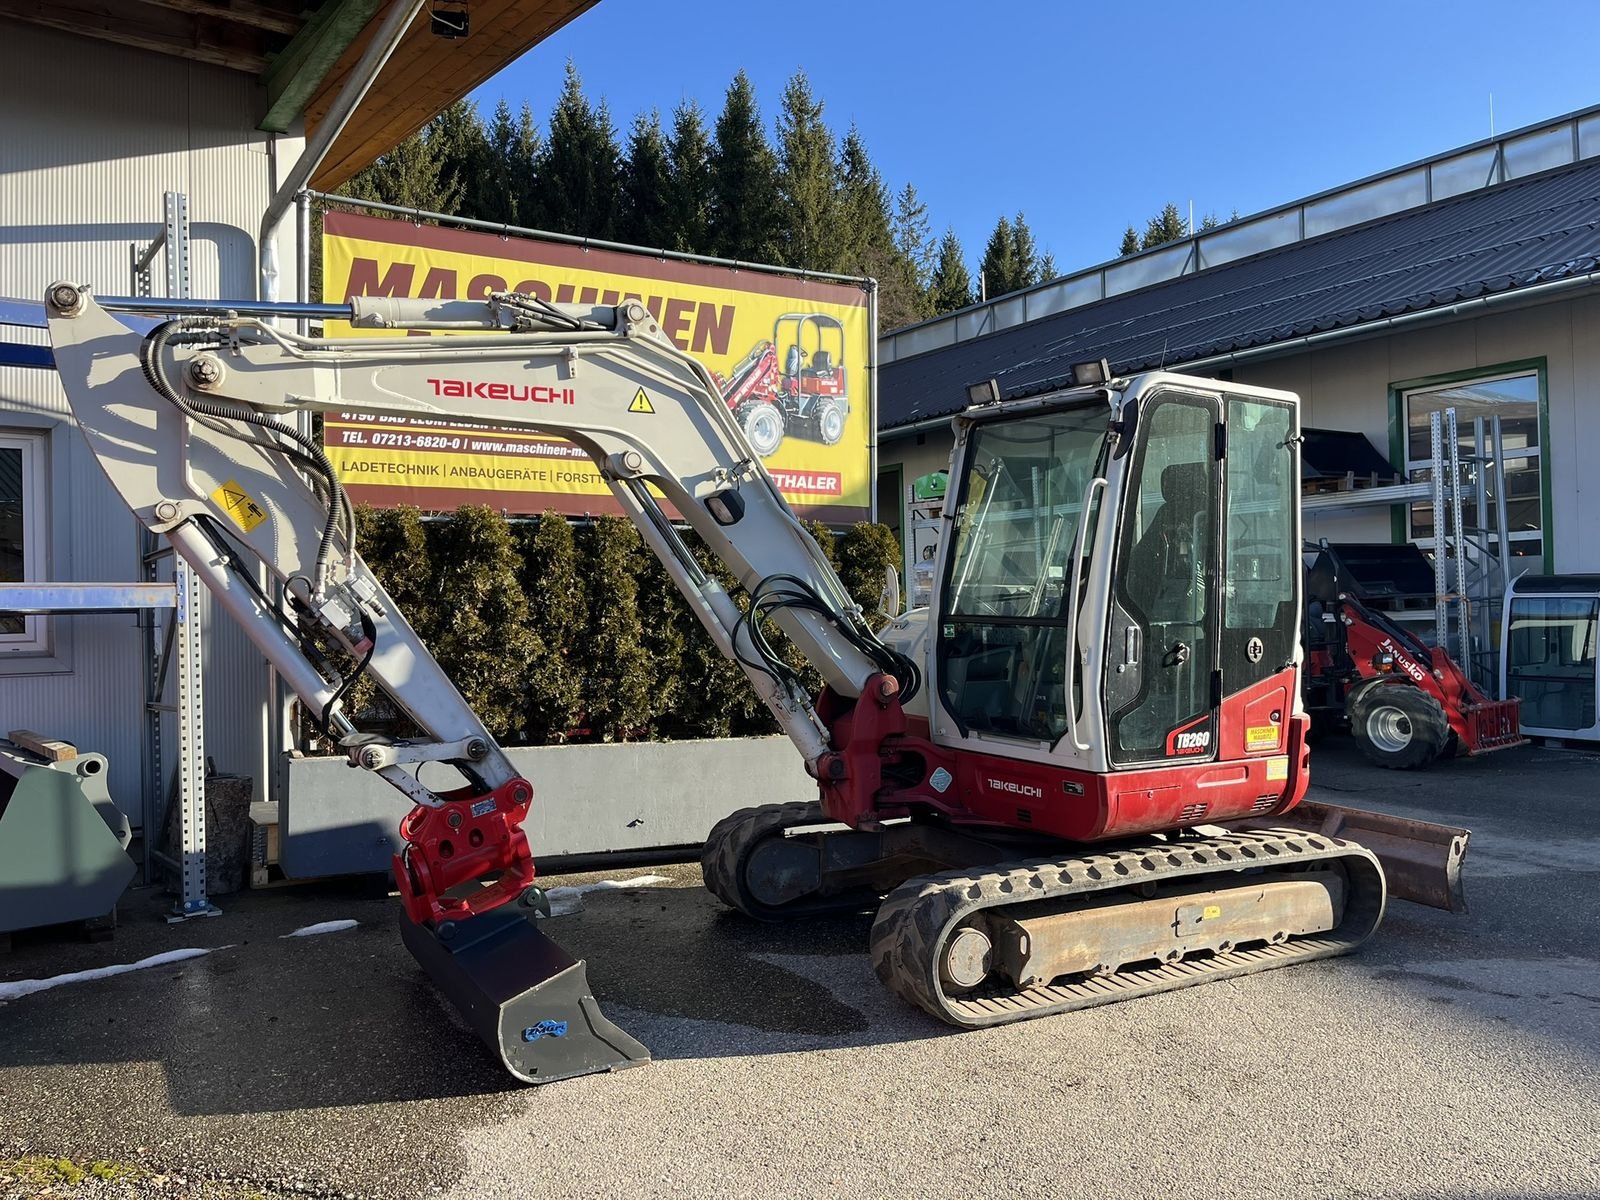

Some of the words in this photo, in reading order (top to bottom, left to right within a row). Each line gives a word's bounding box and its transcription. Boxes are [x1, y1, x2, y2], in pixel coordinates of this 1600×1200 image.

[427, 379, 575, 405] TAKEUCHI
[342, 431, 368, 444] TEL.
[372, 433, 460, 449] 07213-6820-0
[471, 441, 589, 457] www.maschinen-ma
[342, 461, 440, 476] LADETECHNIK
[450, 466, 547, 481] ANBAUGERÄTE
[556, 472, 606, 484] FORSTT
[1177, 731, 1210, 749] TB260
[987, 778, 1042, 798] TAKEUCHI
